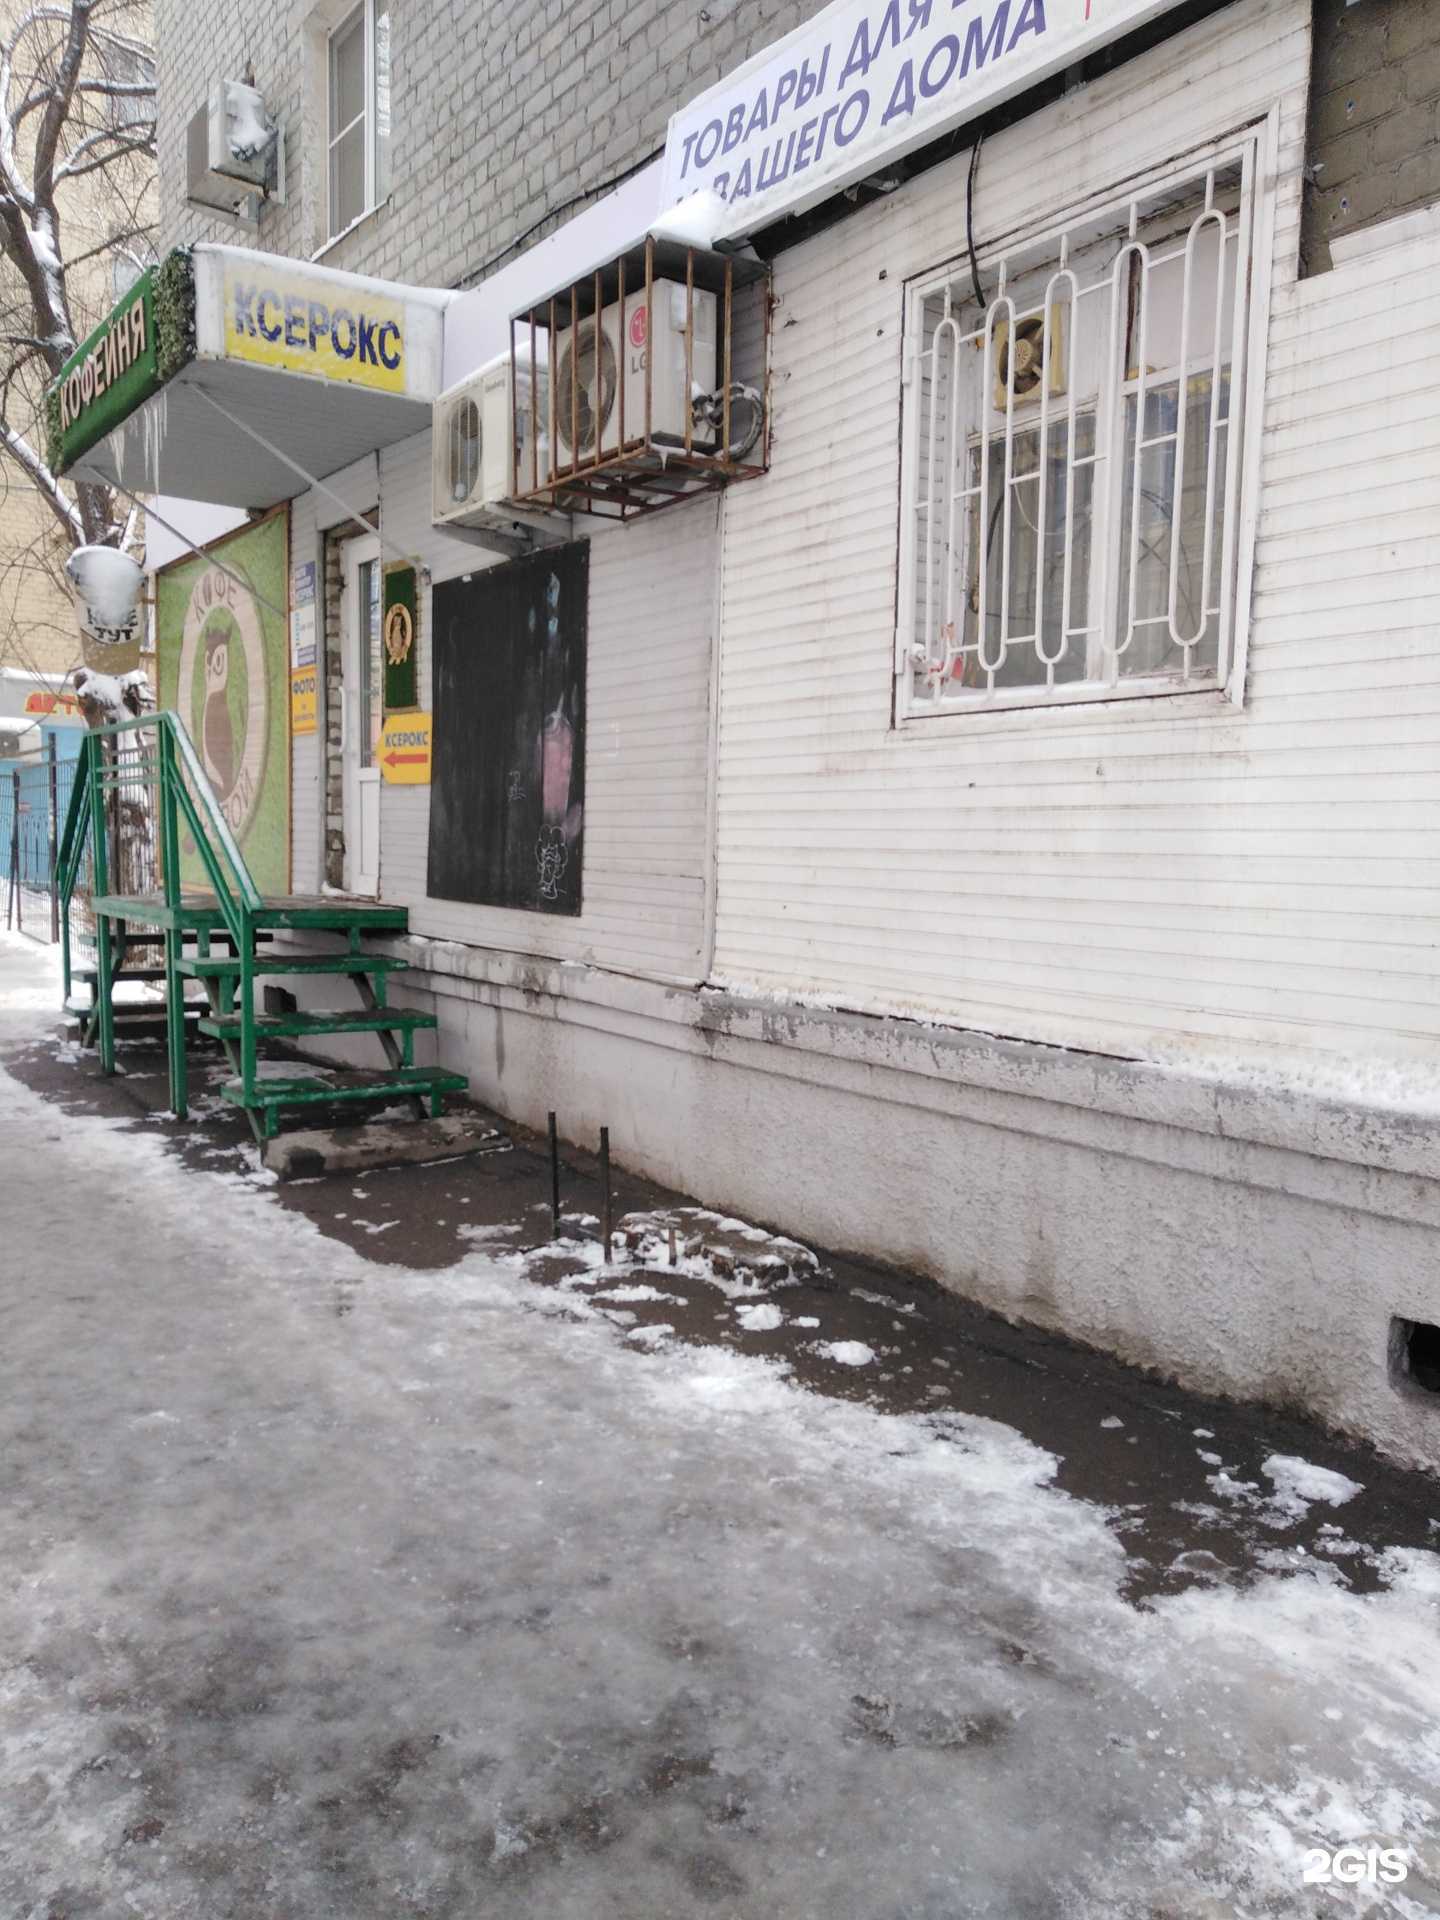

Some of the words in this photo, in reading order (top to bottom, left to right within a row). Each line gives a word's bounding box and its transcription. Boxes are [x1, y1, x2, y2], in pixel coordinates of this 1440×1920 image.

[680, 43, 832, 179] ТОВАРЫ
[838, 0, 935, 91] ДЛЯ
[881, 0, 1047, 126] ДОМА
[60, 297, 146, 432] КОФЕЙНЯ
[234, 282, 402, 371] КСЕРОКС
[292, 677, 316, 696] ФОТО
[384, 730, 430, 749] КСЕРОКС
